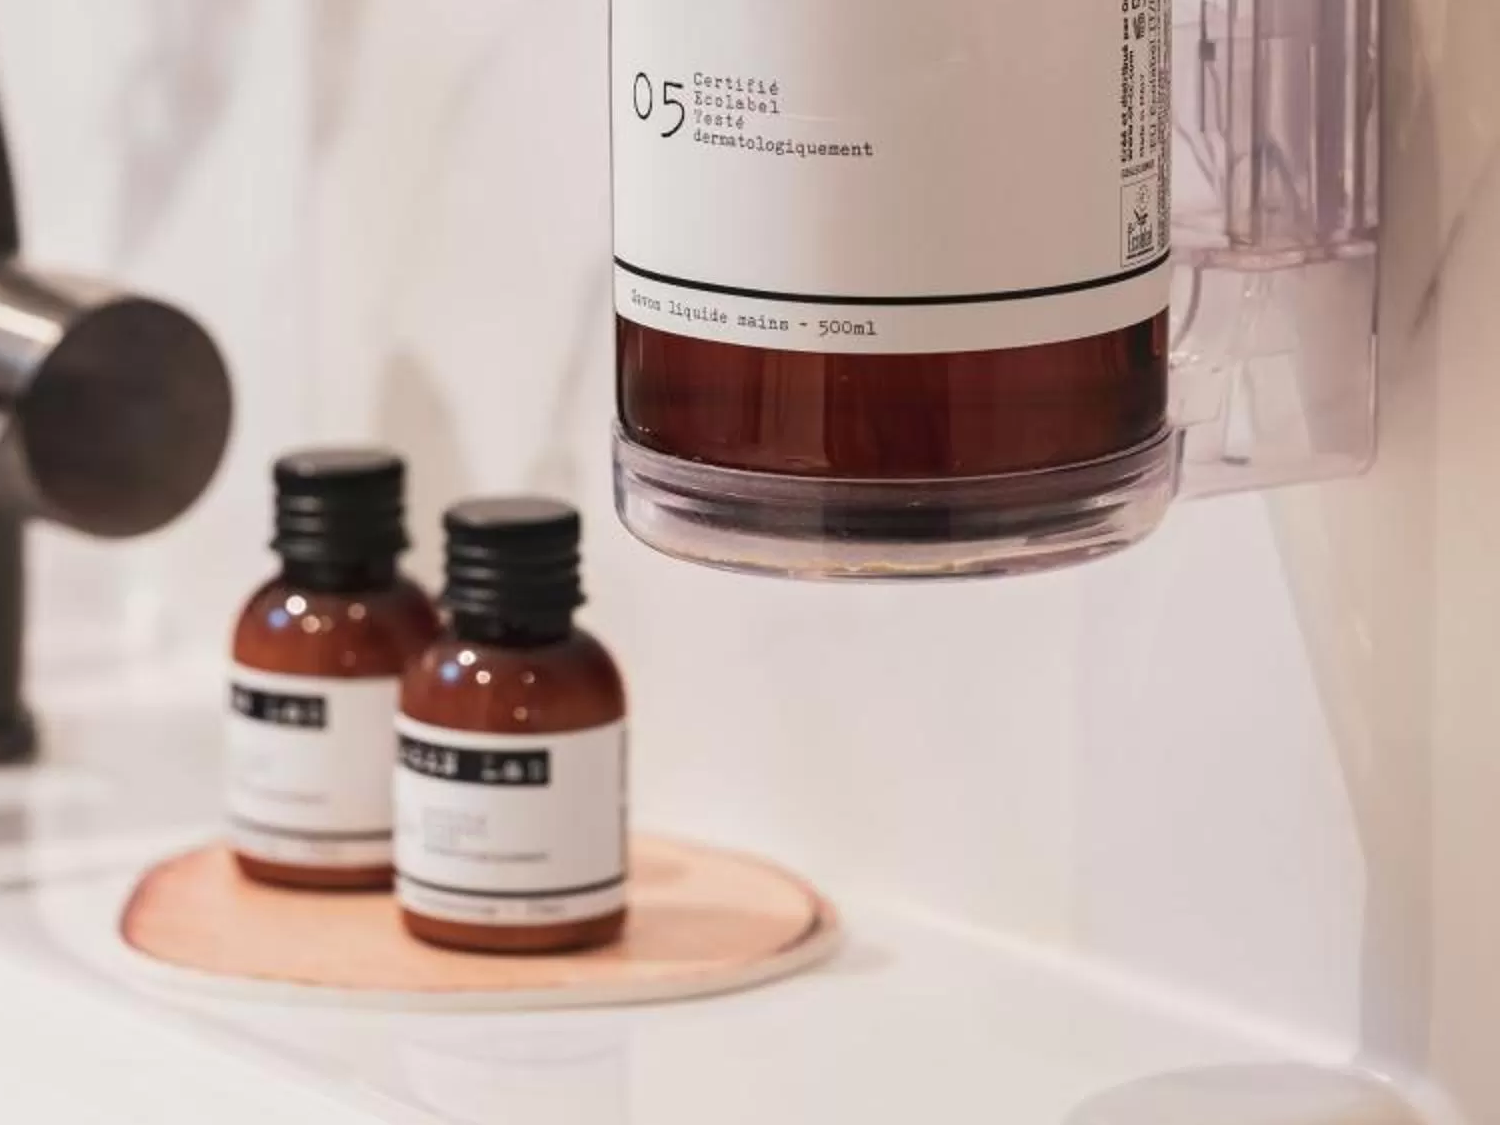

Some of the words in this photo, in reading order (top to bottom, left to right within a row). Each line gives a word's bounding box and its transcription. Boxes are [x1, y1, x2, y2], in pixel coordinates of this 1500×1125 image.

[693, 72, 780, 96] Certifié
[633, 71, 685, 138] 05
[693, 91, 781, 114] Ecolabel
[693, 130, 874, 159] dermatologiquement
[668, 299, 728, 324] liquide
[737, 314, 789, 331] mains
[819, 319, 877, 337] 500ml
